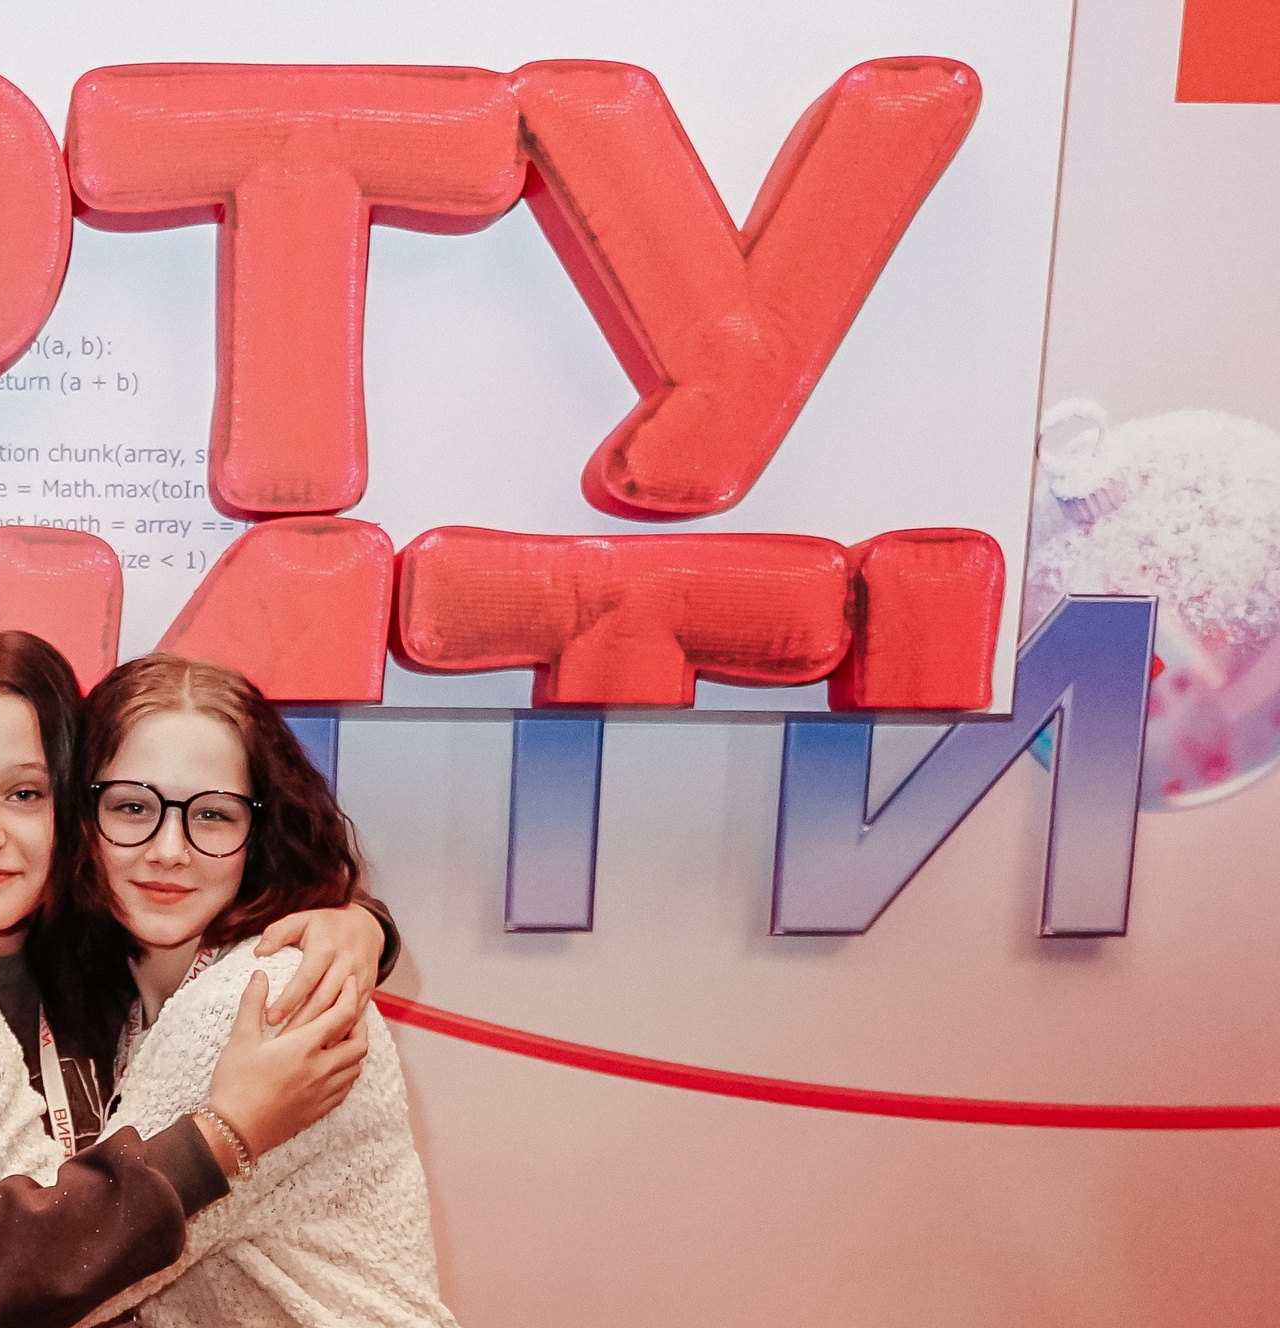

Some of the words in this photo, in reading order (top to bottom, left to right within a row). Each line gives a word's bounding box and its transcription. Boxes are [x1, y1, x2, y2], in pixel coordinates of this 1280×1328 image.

[81, 336, 111, 359] b):
[60, 372, 81, 395] (a
[92, 377, 107, 391] +
[117, 372, 139, 395] b)
[48, 443, 185, 468] chunk(array,
[17, 484, 31, 494] =
[135, 519, 192, 538] array
[117, 550, 150, 568] ize
[186, 551, 207, 574] 1)
